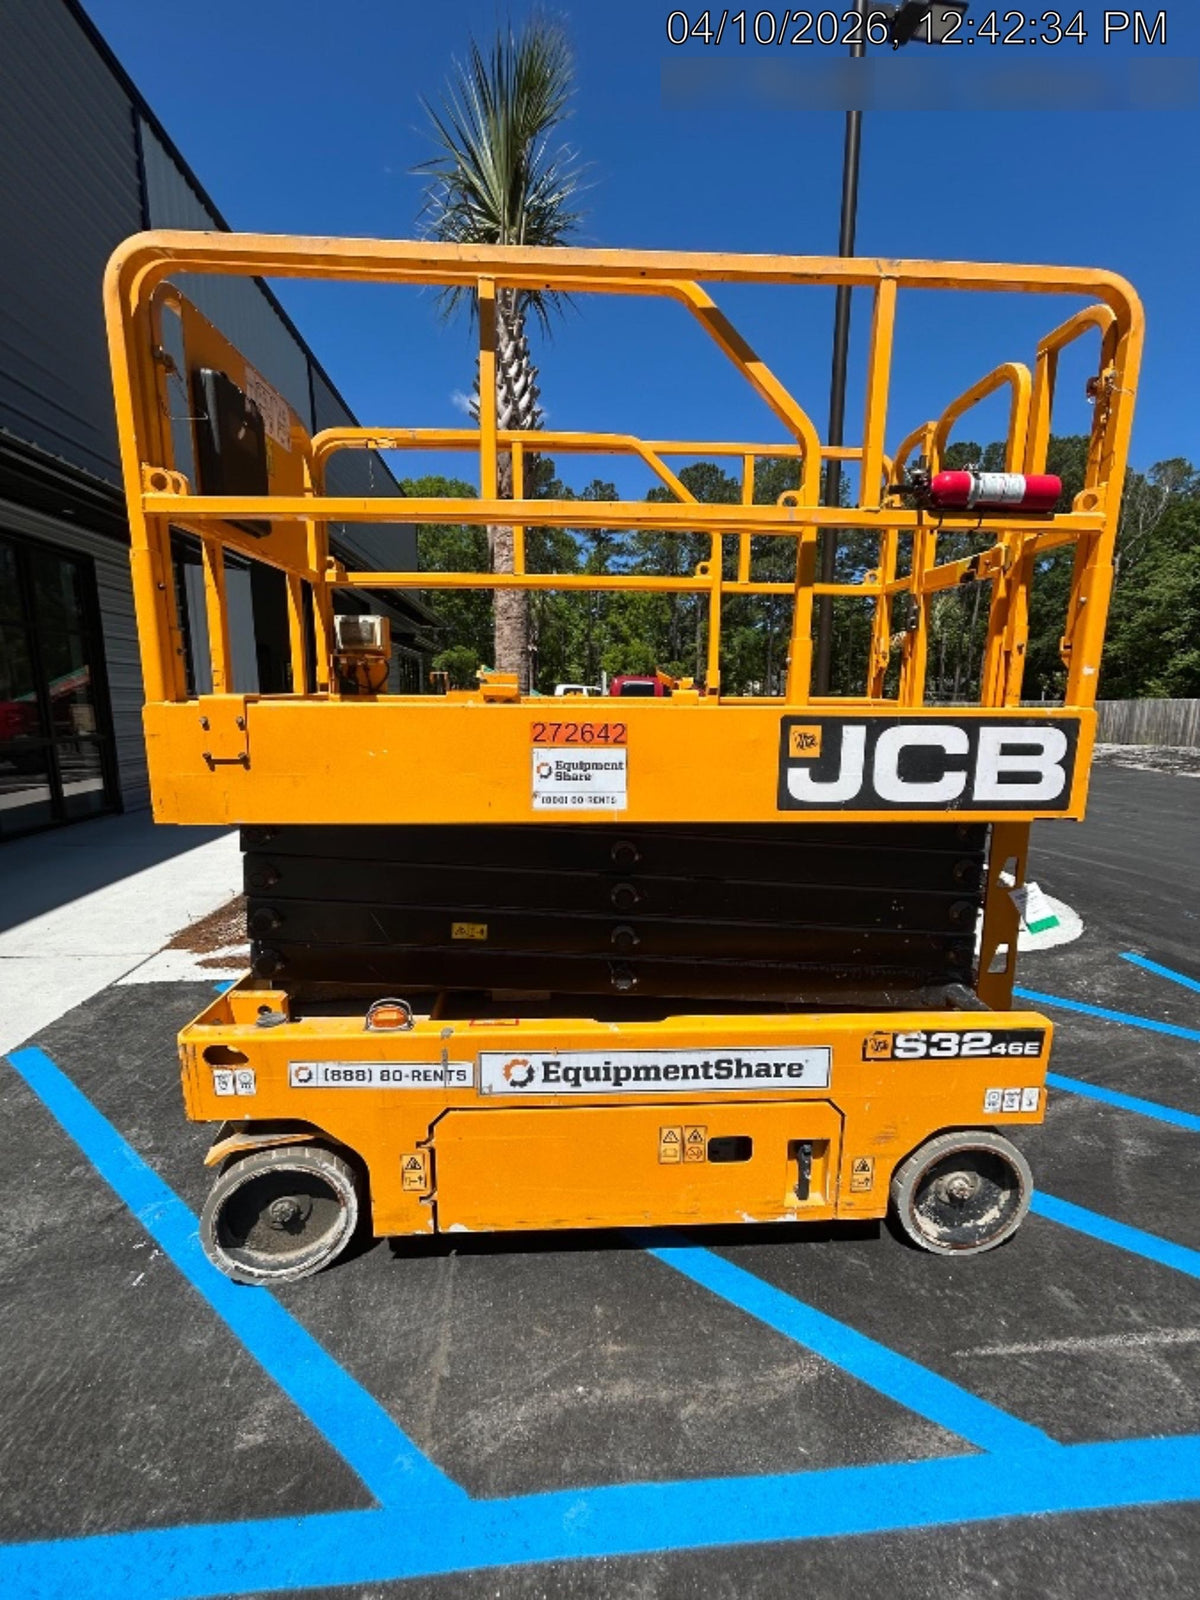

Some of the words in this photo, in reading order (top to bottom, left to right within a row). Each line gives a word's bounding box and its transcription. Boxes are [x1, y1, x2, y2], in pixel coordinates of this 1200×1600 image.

[532, 722, 626, 744] 272642
[555, 760, 624, 772] Equipment
[786, 724, 1068, 802] JCB
[555, 772, 592, 781] Share
[324, 1068, 372, 1082] (888)
[379, 1069, 467, 1082] 80-RENTS
[541, 1058, 804, 1087] EquipmentShare
